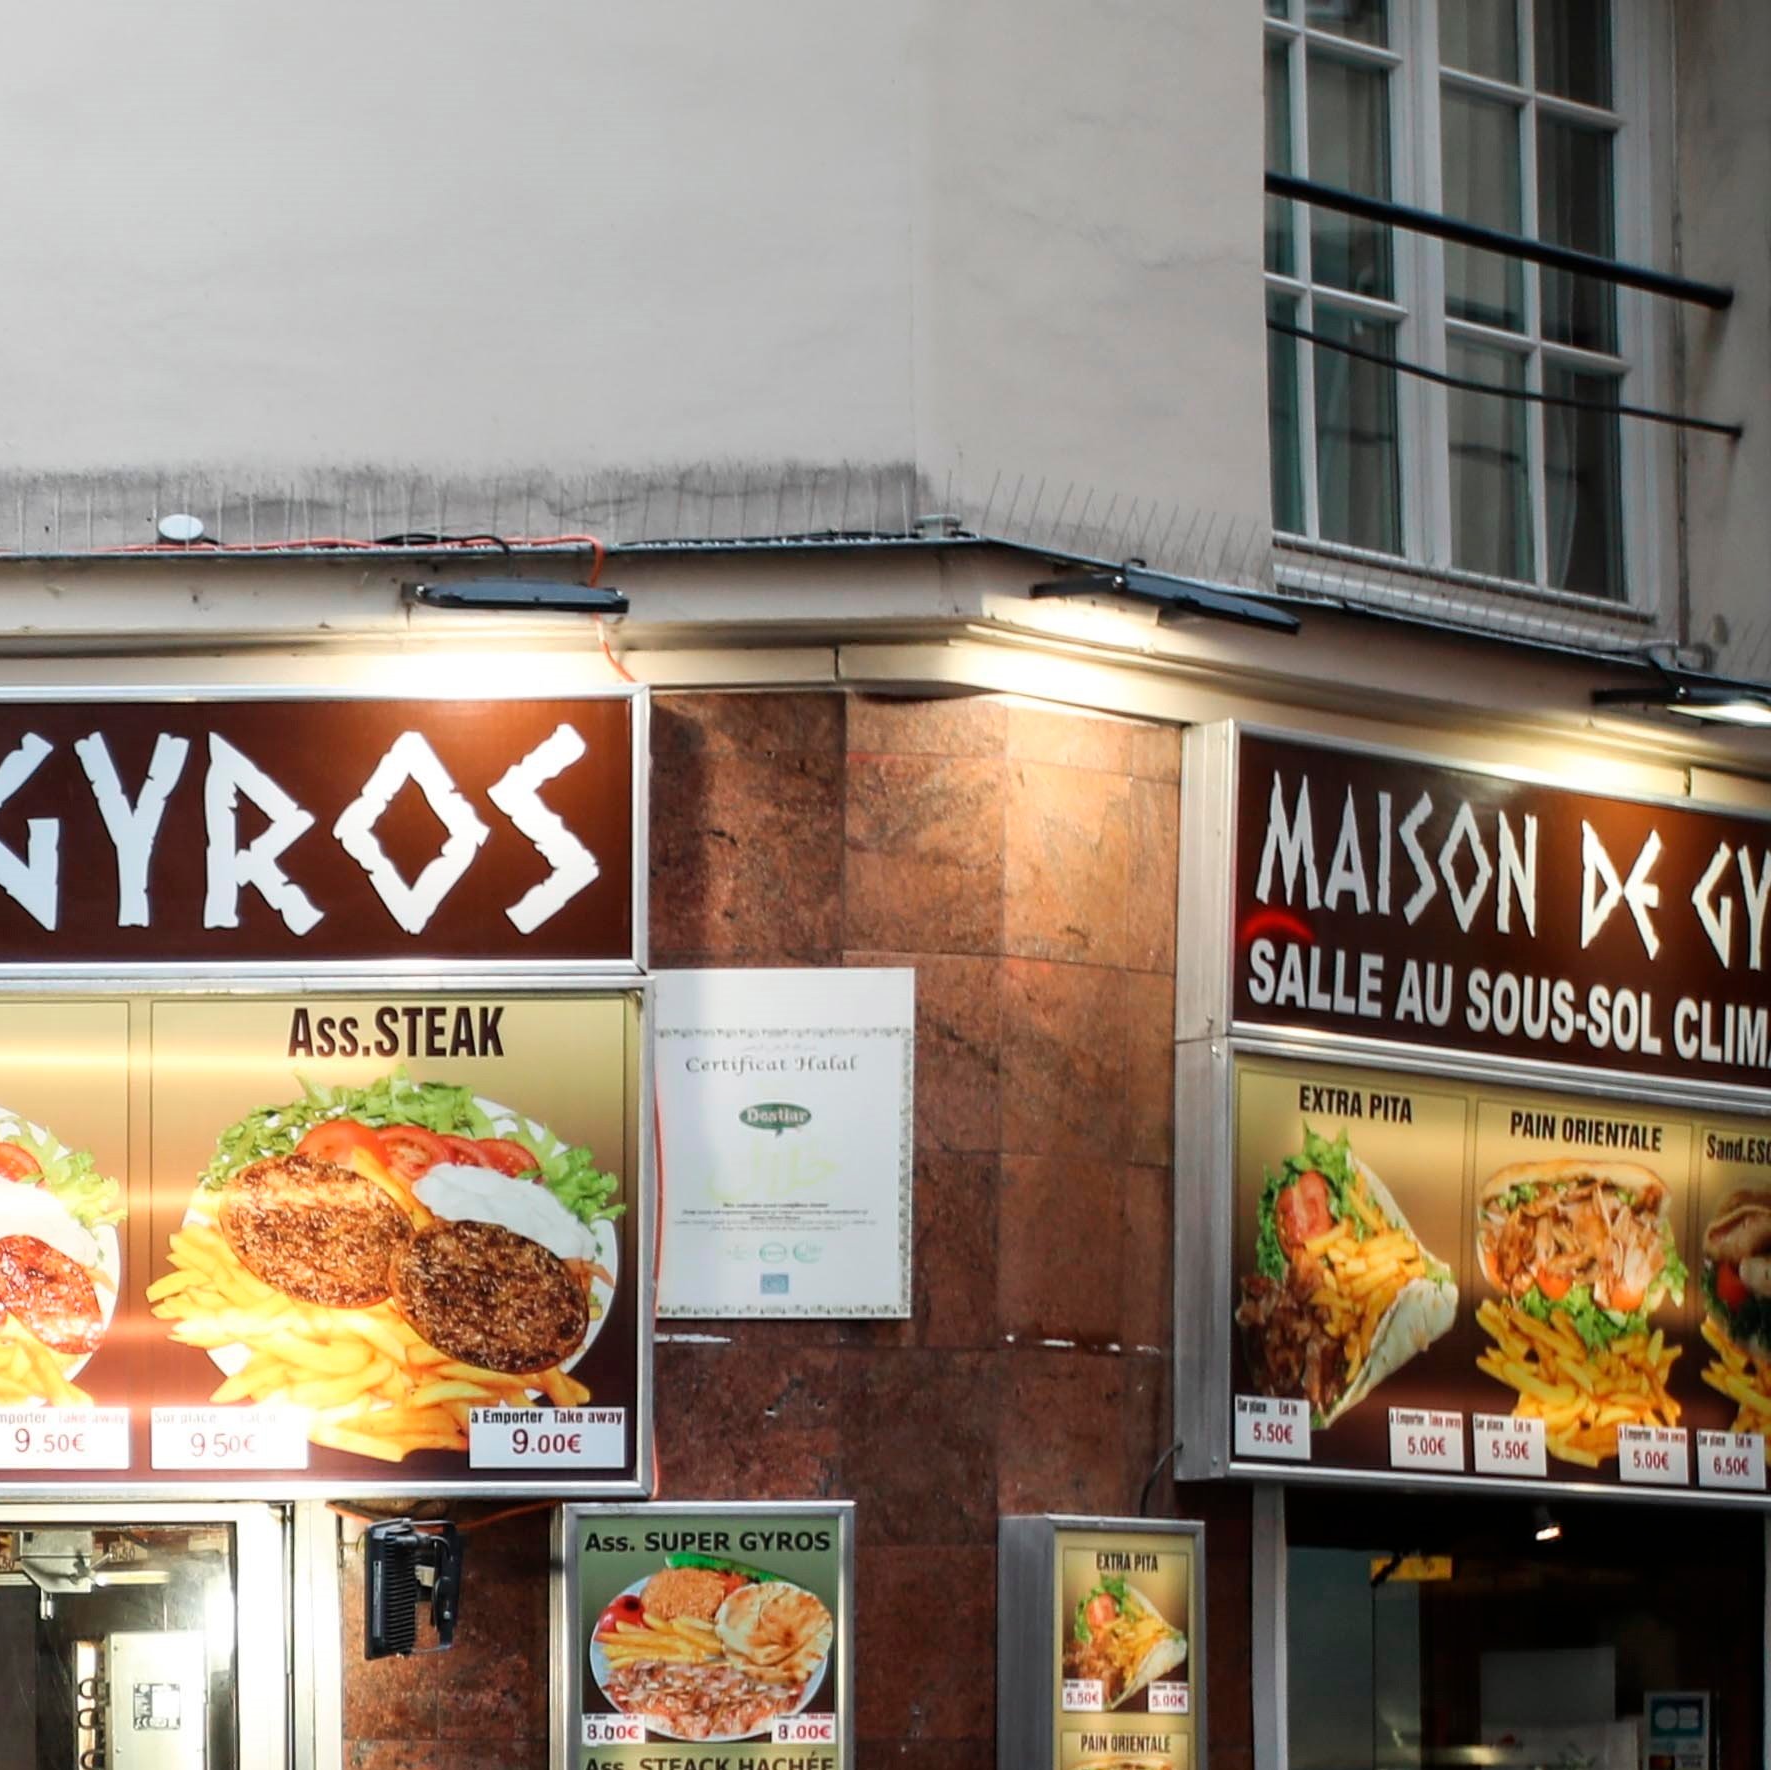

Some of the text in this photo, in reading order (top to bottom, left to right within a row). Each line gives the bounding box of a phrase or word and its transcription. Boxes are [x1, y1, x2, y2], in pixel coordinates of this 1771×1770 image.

[1255, 769, 1538, 939] MAISON
[1581, 818, 1664, 961] DE
[1247, 937, 1771, 1069] SALLE AU SOUS-SOL CLIM
[685, 1053, 859, 1076] Certificat Halal
[1299, 1085, 1413, 1125] EXTRA PITA
[1510, 1111, 1663, 1153] PAIN ORIENTALE
[15, 1427, 85, 1456] 9.50€
[512, 1428, 583, 1456] 9.00€
[584, 1530, 831, 1553] Ass. SUPER GYROS
[1096, 1551, 1159, 1573] EXTRA PITA
[1080, 1733, 1171, 1754] PAIN ORIENTALE
